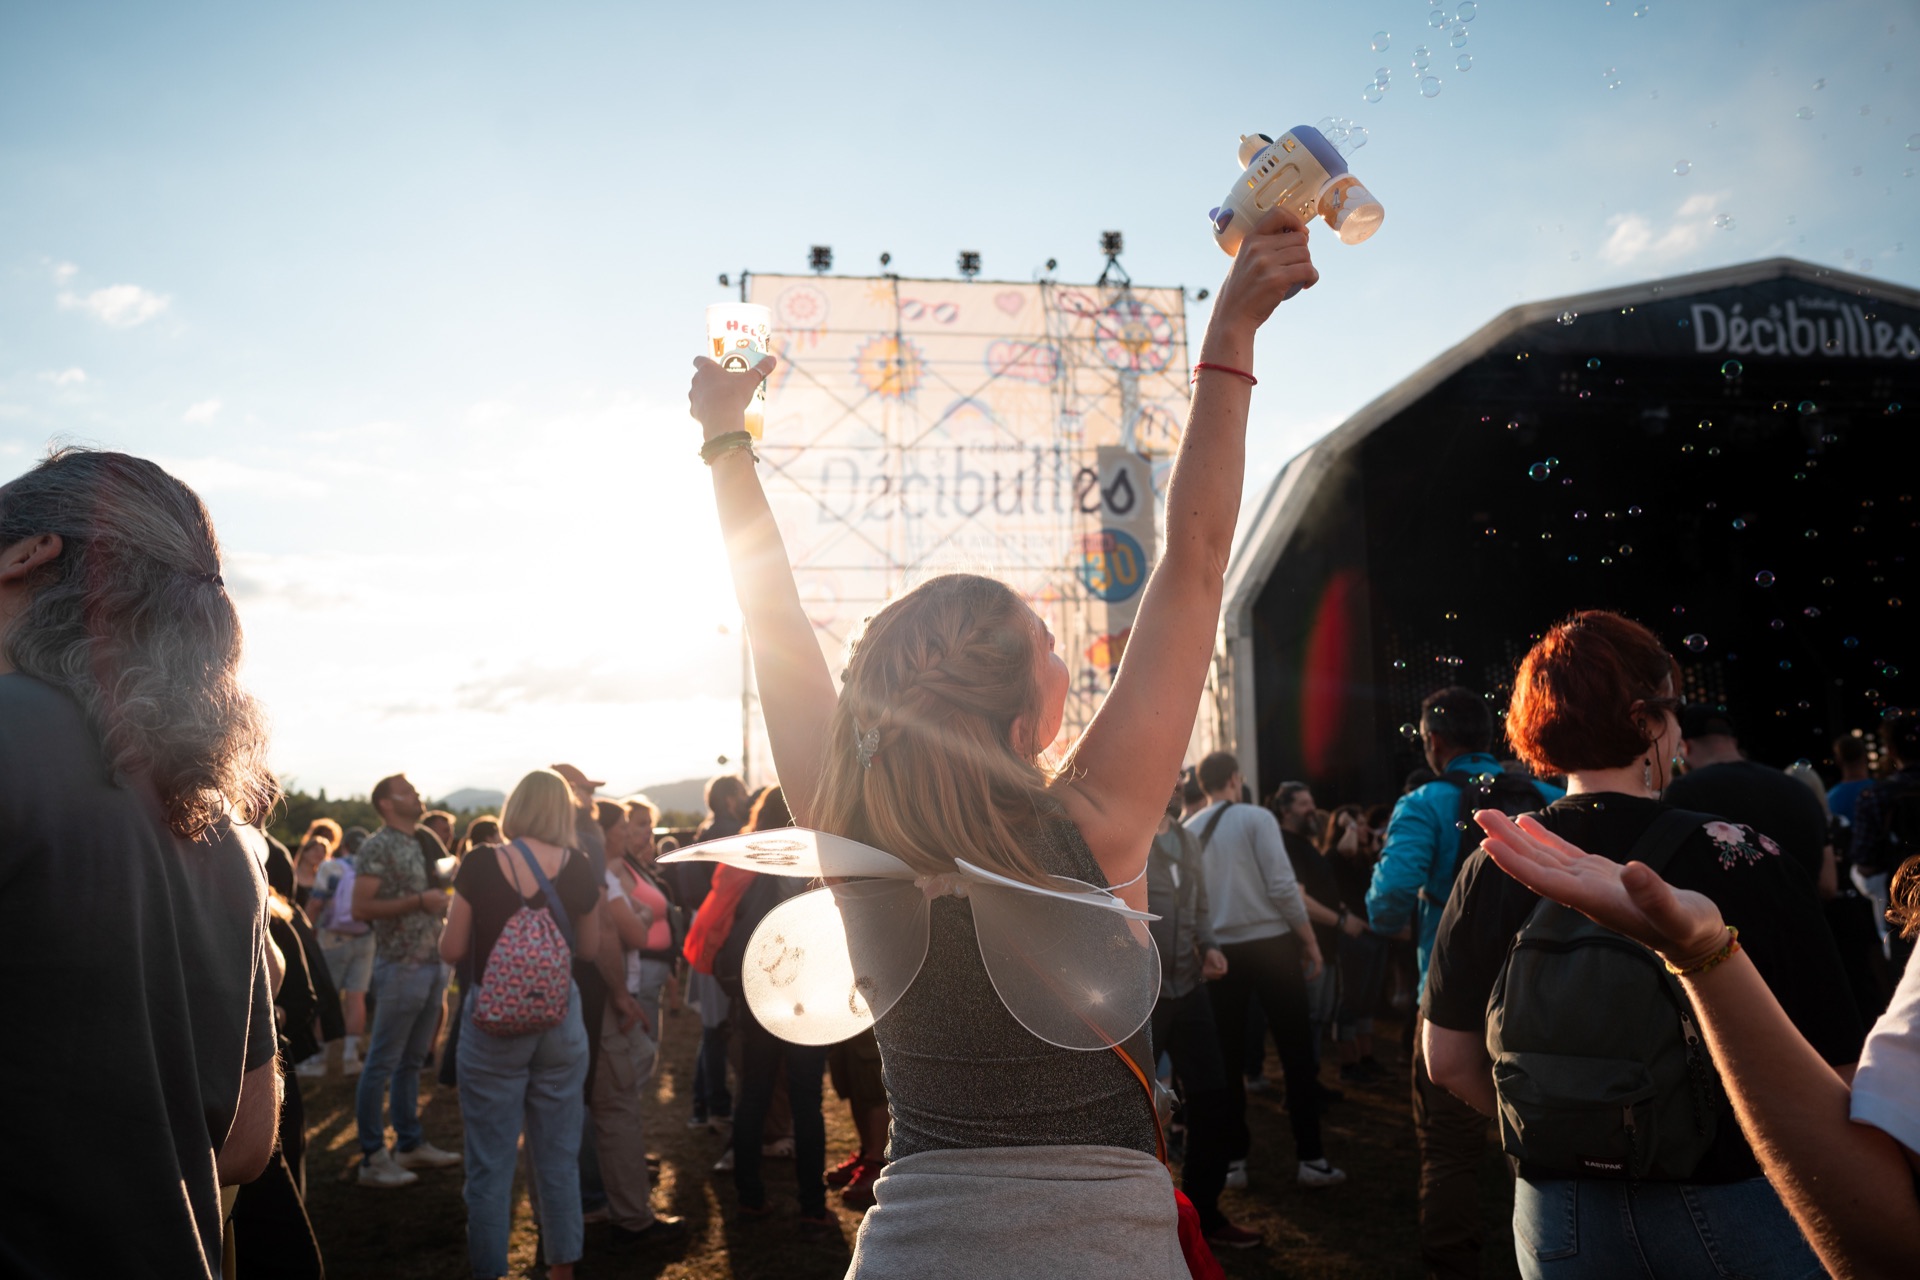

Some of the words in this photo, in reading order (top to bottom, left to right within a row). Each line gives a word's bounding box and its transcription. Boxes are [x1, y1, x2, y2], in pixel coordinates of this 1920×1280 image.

[1690, 299, 1920, 360] Décibulles
[817, 447, 1135, 524] Décibulles
[1086, 542, 1138, 591] 30
[1584, 1160, 1622, 1170] EASTPAK
